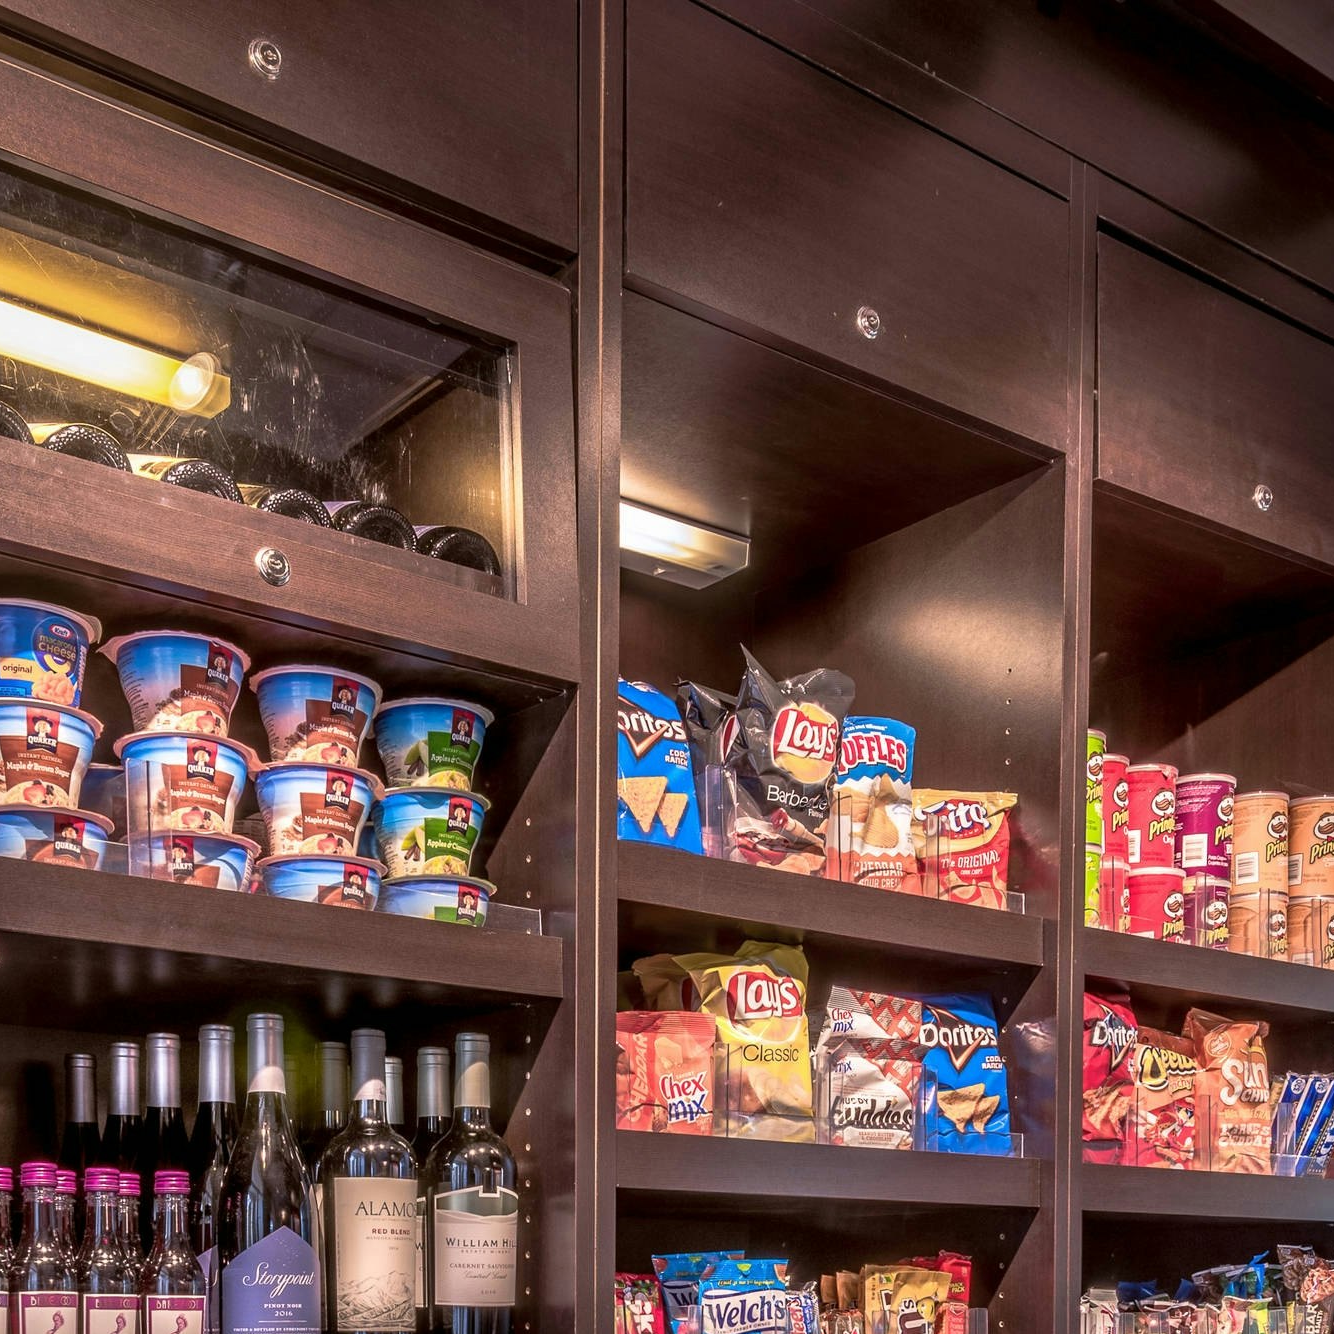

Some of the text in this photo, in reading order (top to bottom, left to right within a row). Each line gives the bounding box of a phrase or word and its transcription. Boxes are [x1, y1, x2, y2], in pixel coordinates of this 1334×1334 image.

[2, 664, 33, 674] original
[332, 701, 354, 714] QUAKER
[27, 735, 58, 748] QUAKER
[779, 710, 838, 760] Lay's
[6, 760, 25, 772] Maple
[33, 764, 53, 776] Brown
[187, 764, 215, 776] QUAKER
[325, 793, 350, 806] QUAKER
[768, 784, 828, 812] Barbecue
[304, 816, 322, 826] Maple
[427, 838, 445, 850] Apples
[957, 850, 1000, 868] ORIGINAL
[735, 973, 799, 1018] Lay's
[831, 1008, 852, 1022] Chex
[919, 1023, 997, 1047] Doritos
[743, 1043, 799, 1064] Classic
[660, 1072, 707, 1100] Chex
[446, 1237, 498, 1248] WILLIAM
[242, 1261, 315, 1298] Storypoint
[705, 1296, 786, 1330] Welch's
